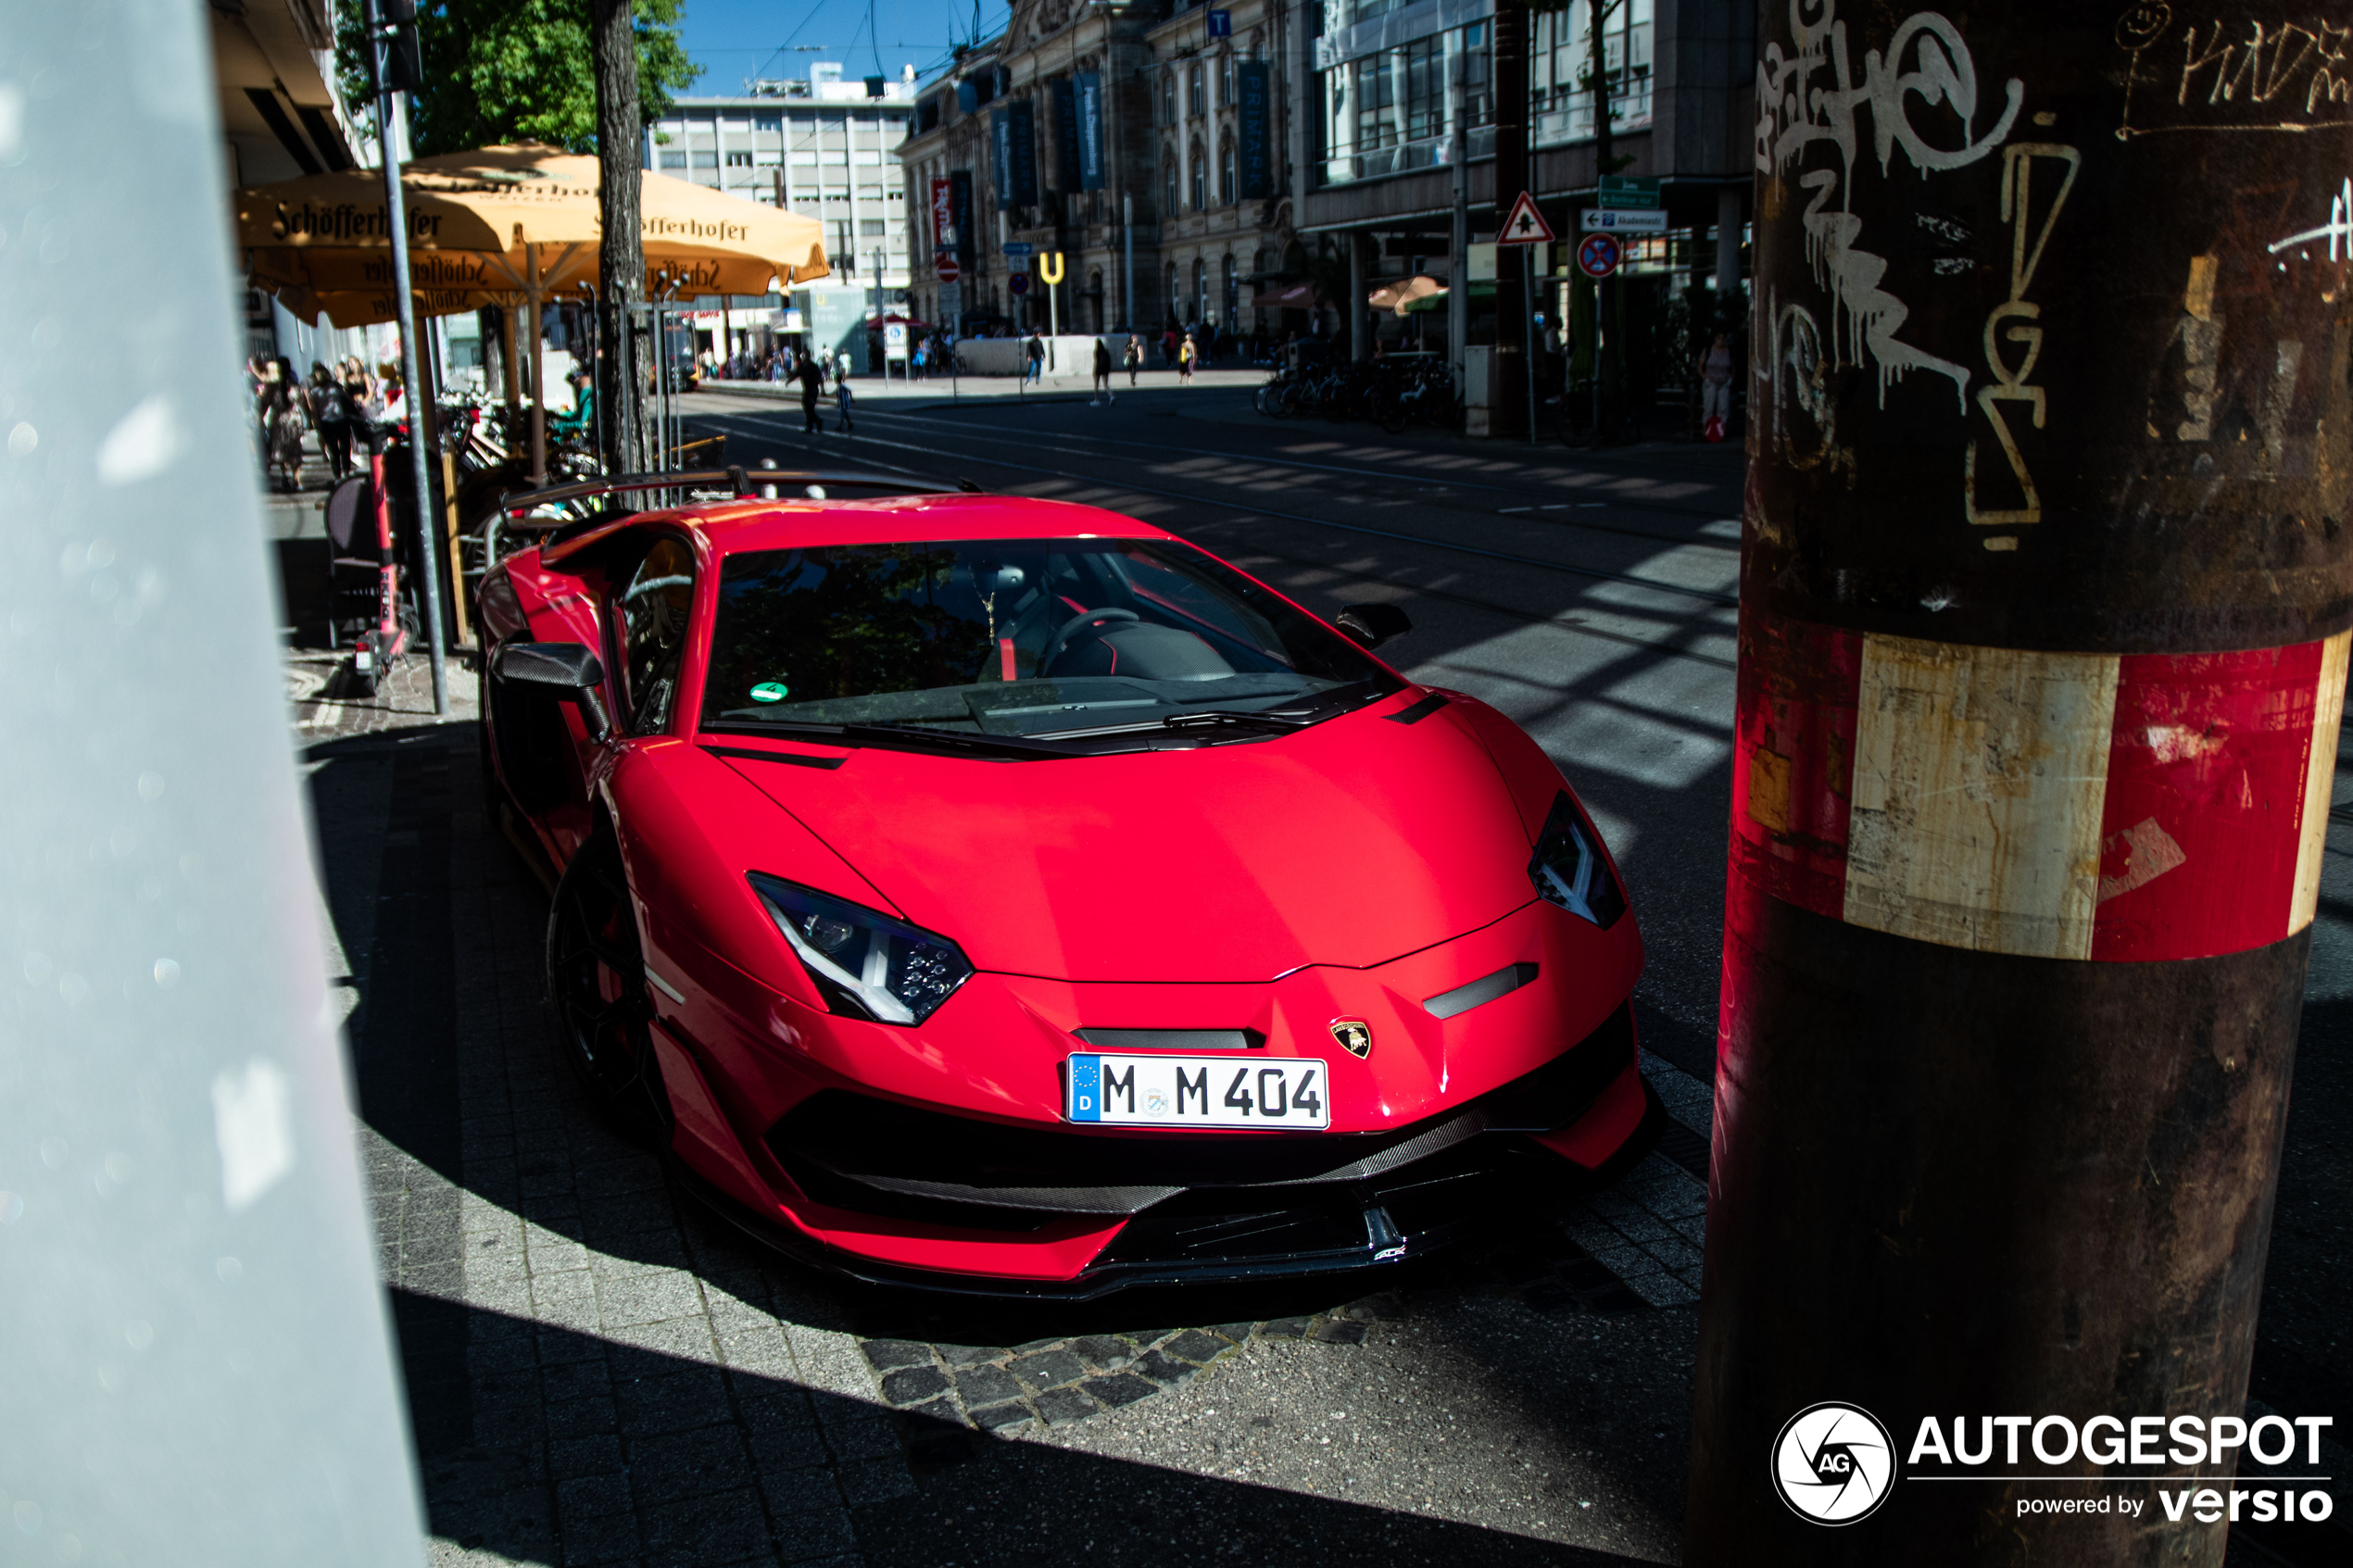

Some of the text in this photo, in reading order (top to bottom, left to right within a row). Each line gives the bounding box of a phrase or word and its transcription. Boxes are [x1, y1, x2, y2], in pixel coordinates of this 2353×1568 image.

[1212, 13, 1226, 33] T
[1061, 94, 1076, 176] PRIMARK
[1246, 76, 1263, 188] PRIMARK
[1016, 114, 1032, 193] PRIMARK
[478, 194, 562, 203] WEIZEN
[273, 199, 442, 241] Schöfferhfer
[1039, 252, 1064, 284] U
[816, 294, 825, 307] U
[765, 684, 777, 693] 4
[1079, 1095, 1092, 1111] D
[1103, 1064, 1136, 1114] M
[1176, 1066, 1208, 1116] M
[1224, 1068, 1322, 1118] 404
